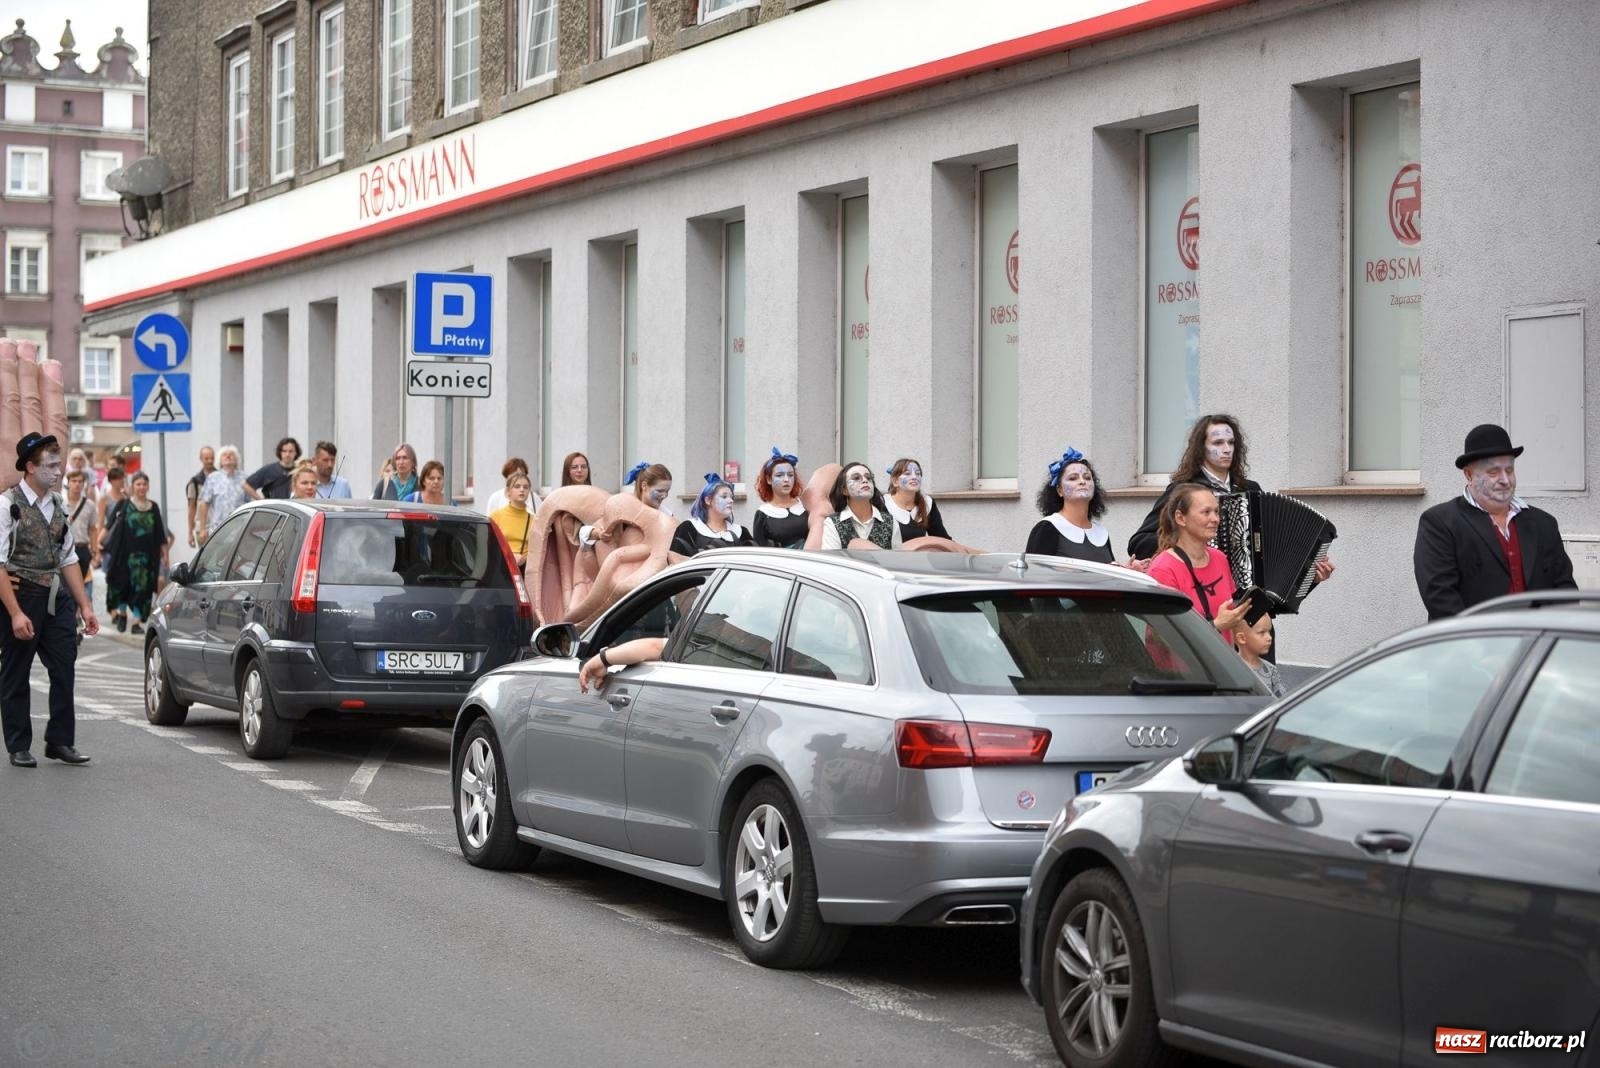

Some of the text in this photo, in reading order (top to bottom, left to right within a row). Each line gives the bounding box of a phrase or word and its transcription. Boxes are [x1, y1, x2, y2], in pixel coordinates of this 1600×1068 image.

[359, 132, 476, 220] ROSSMANN
[430, 282, 476, 346] P
[444, 334, 485, 350] Płatny
[410, 369, 488, 389] Koniec
[387, 653, 461, 669] SRC 5UL7
